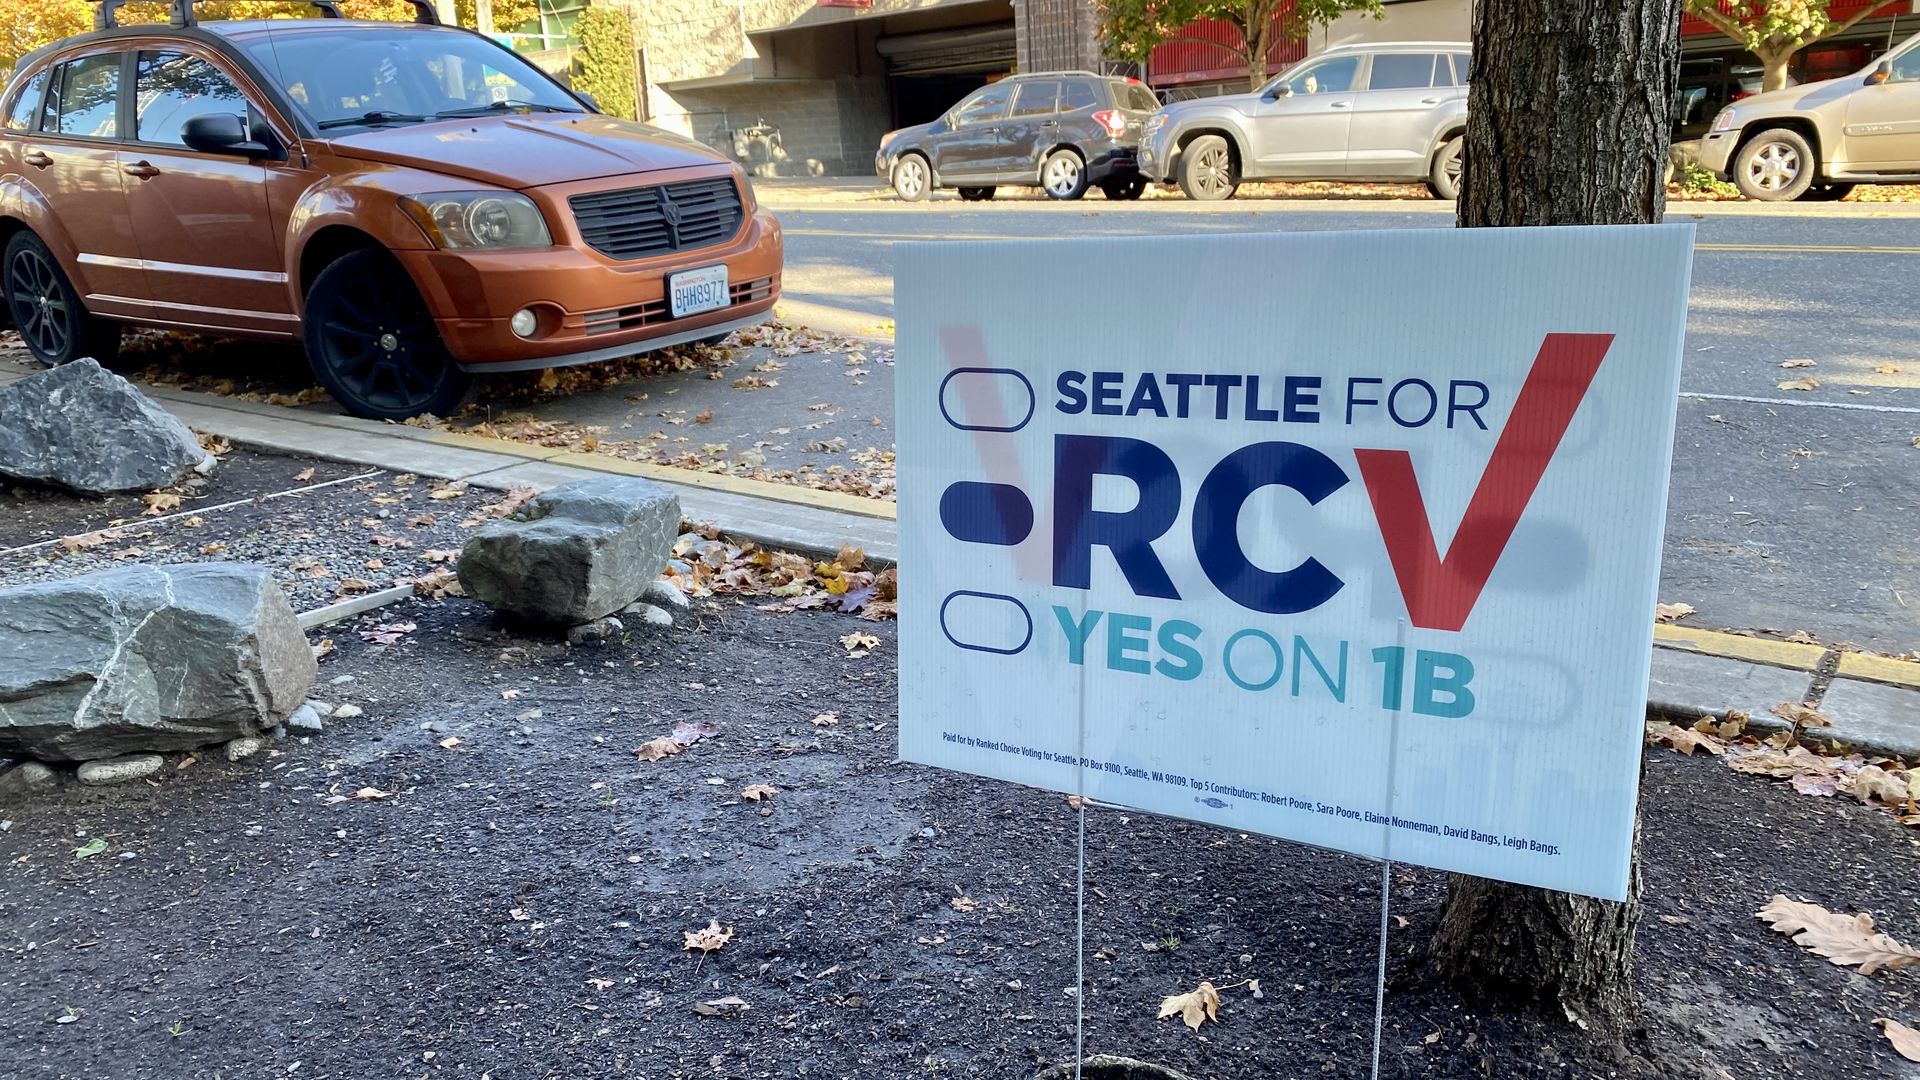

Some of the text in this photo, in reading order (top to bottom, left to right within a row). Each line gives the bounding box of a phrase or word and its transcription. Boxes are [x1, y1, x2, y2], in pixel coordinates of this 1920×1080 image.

[675, 280, 724, 308] BHH8977
[1055, 370, 1490, 430] SEATTLE FOR
[1053, 332, 1616, 632] RCV
[1051, 605, 1476, 719] YES ON 1B
[943, 732, 1561, 855] Paid for by Ranked Choice Voting for Seattle. PO Box 9100, Seattle, WA 98109. Top 5 Contributors: Robert Poore, Sara Poore, Elaine Nonneman, David Bangs, Leigh Bangs.
